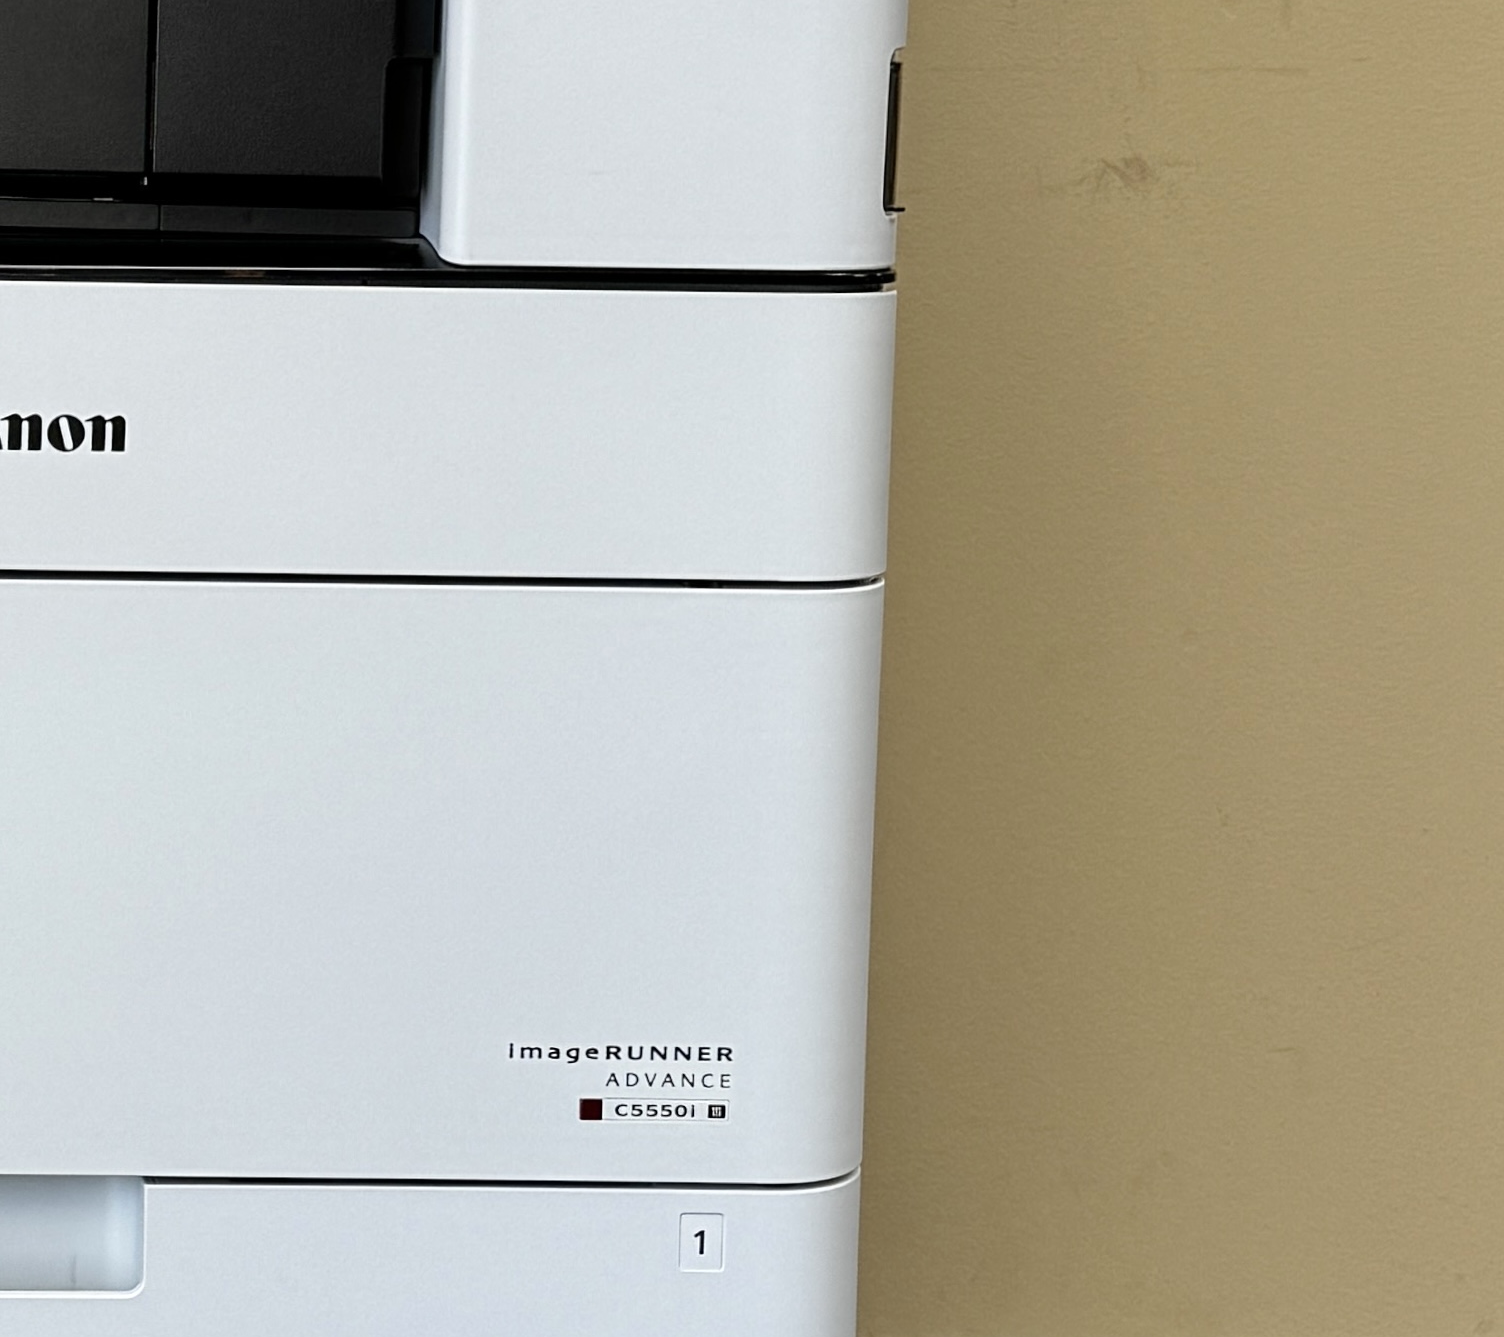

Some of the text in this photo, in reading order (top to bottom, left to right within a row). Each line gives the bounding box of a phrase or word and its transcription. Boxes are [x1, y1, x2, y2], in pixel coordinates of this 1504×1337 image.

[605, 1072, 731, 1089] ADVANCE
[614, 1104, 696, 1118] C5550i
[693, 1229, 706, 1256] 1
